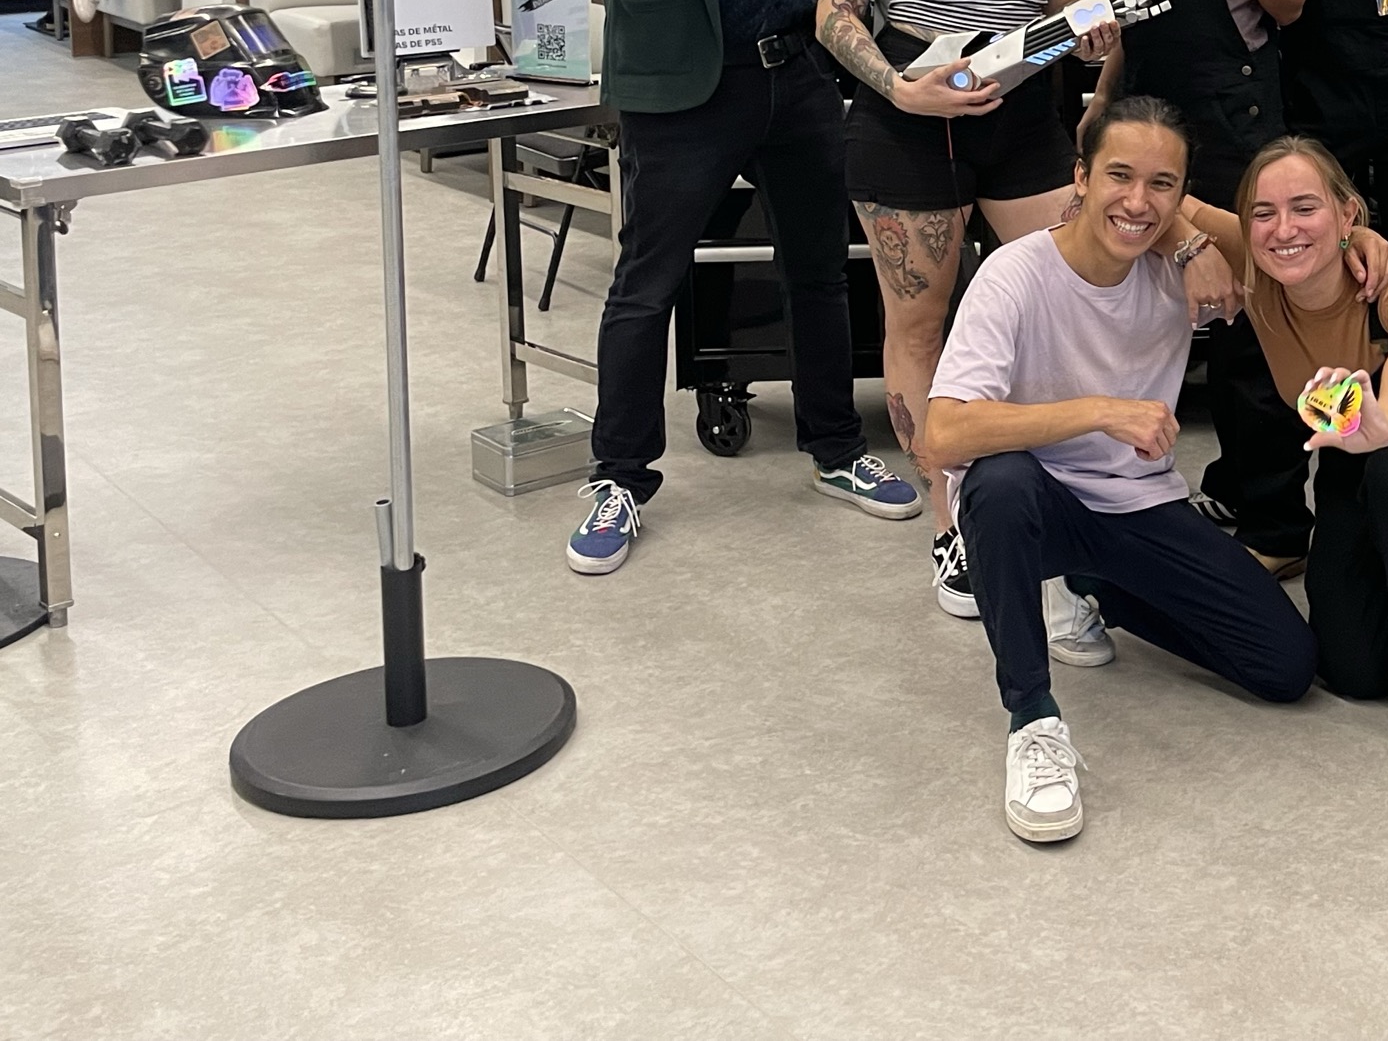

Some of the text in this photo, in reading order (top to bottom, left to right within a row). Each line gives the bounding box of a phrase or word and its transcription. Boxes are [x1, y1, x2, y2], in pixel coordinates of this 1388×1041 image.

[423, 23, 453, 34] MÉTAL
[395, 38, 443, 49] AS DE PS5
